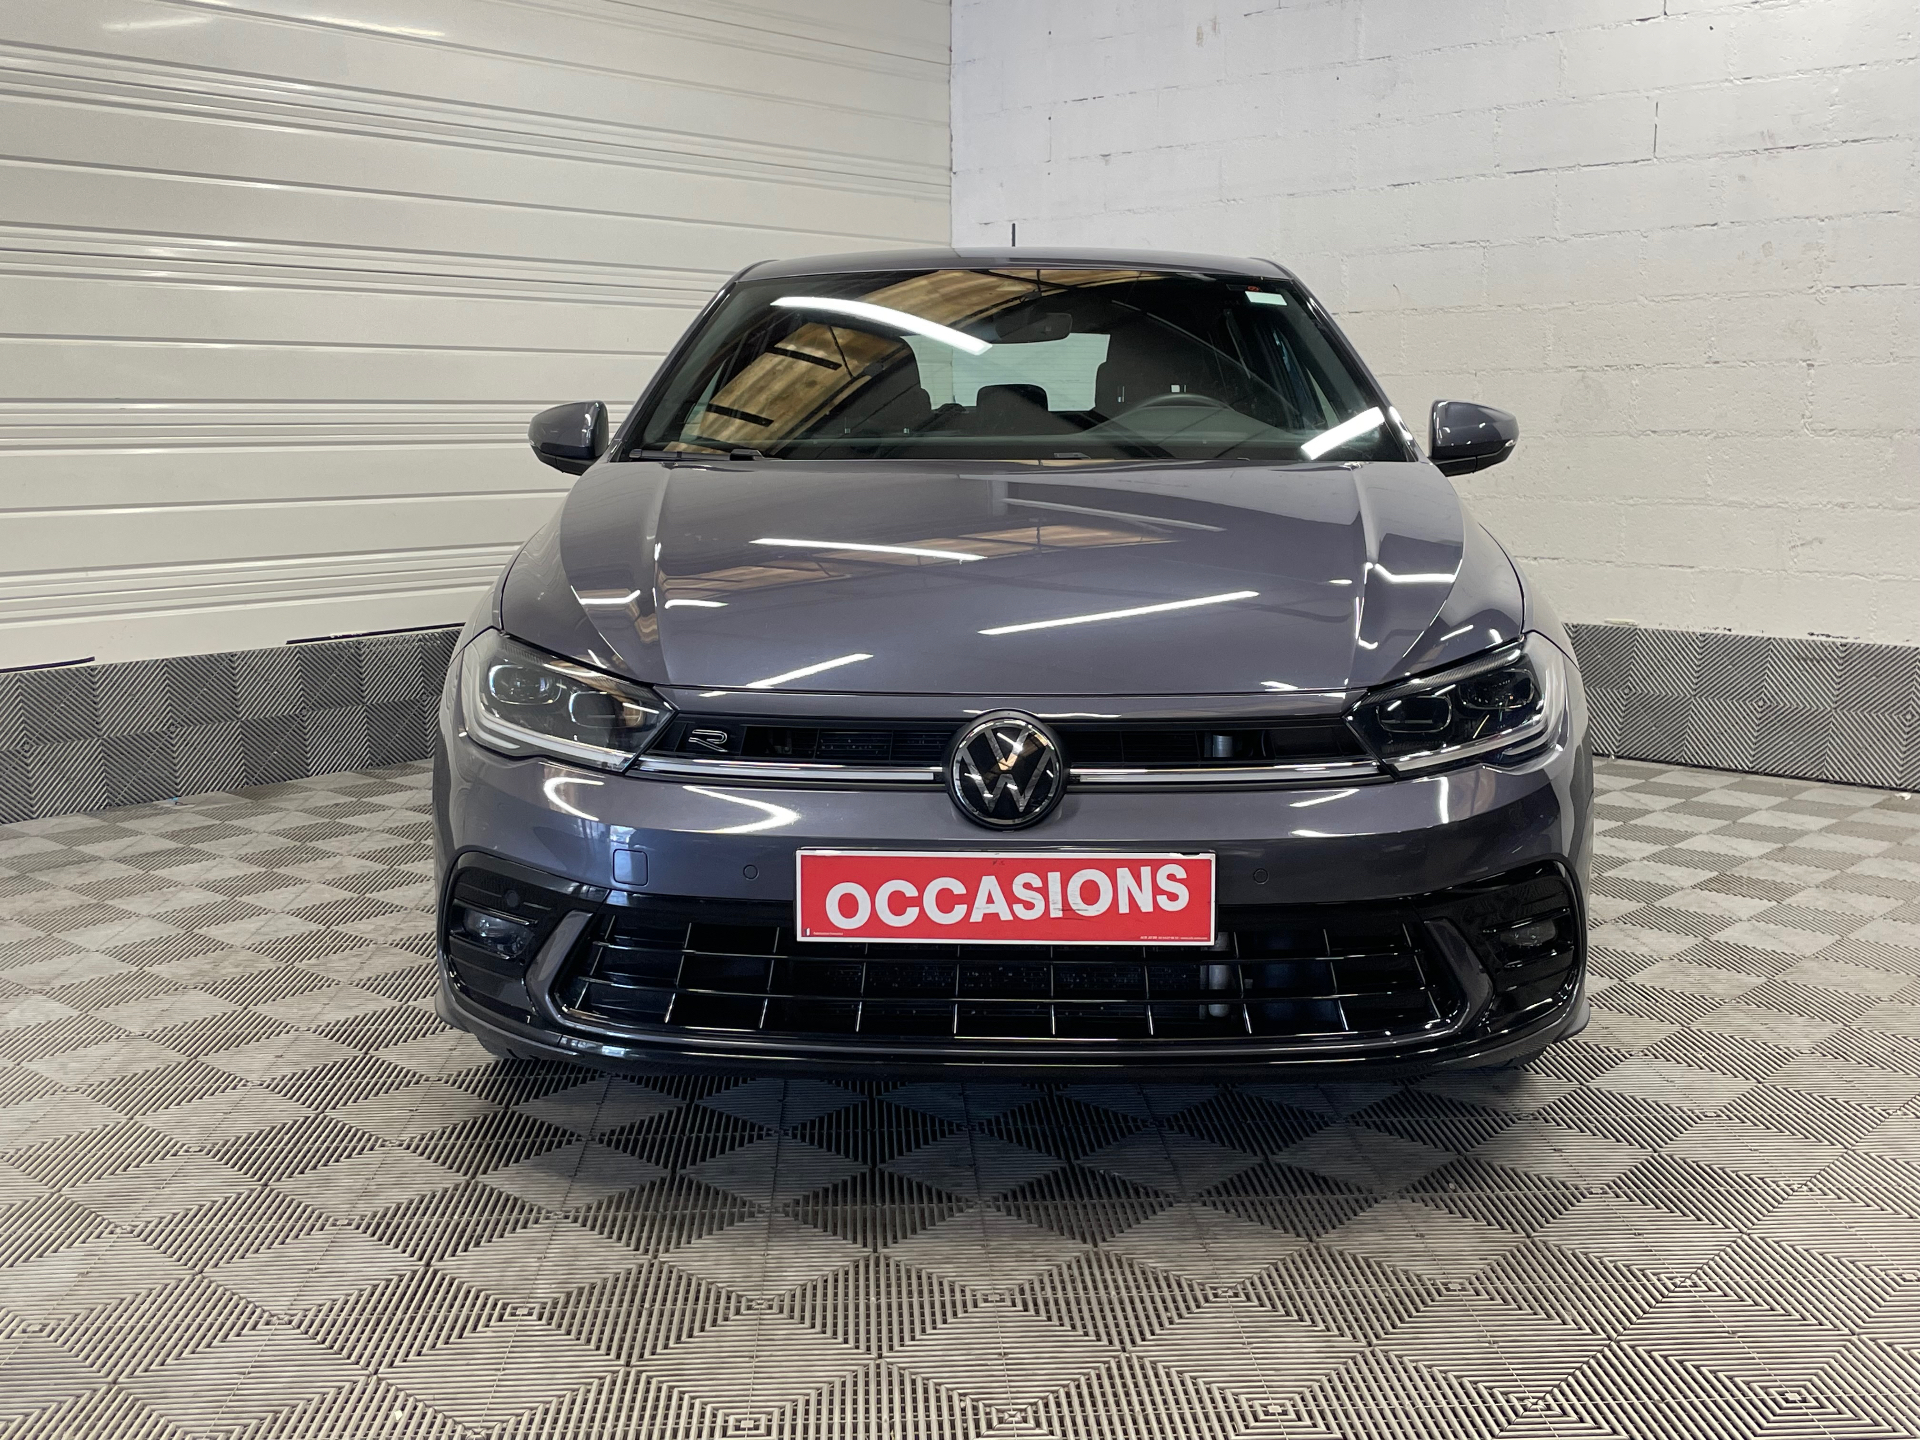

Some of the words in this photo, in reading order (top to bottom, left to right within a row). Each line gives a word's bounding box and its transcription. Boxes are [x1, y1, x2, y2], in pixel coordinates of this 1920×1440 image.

[688, 729, 728, 752] R
[957, 722, 1057, 820] VW
[826, 864, 1190, 929] OCCASIONS
